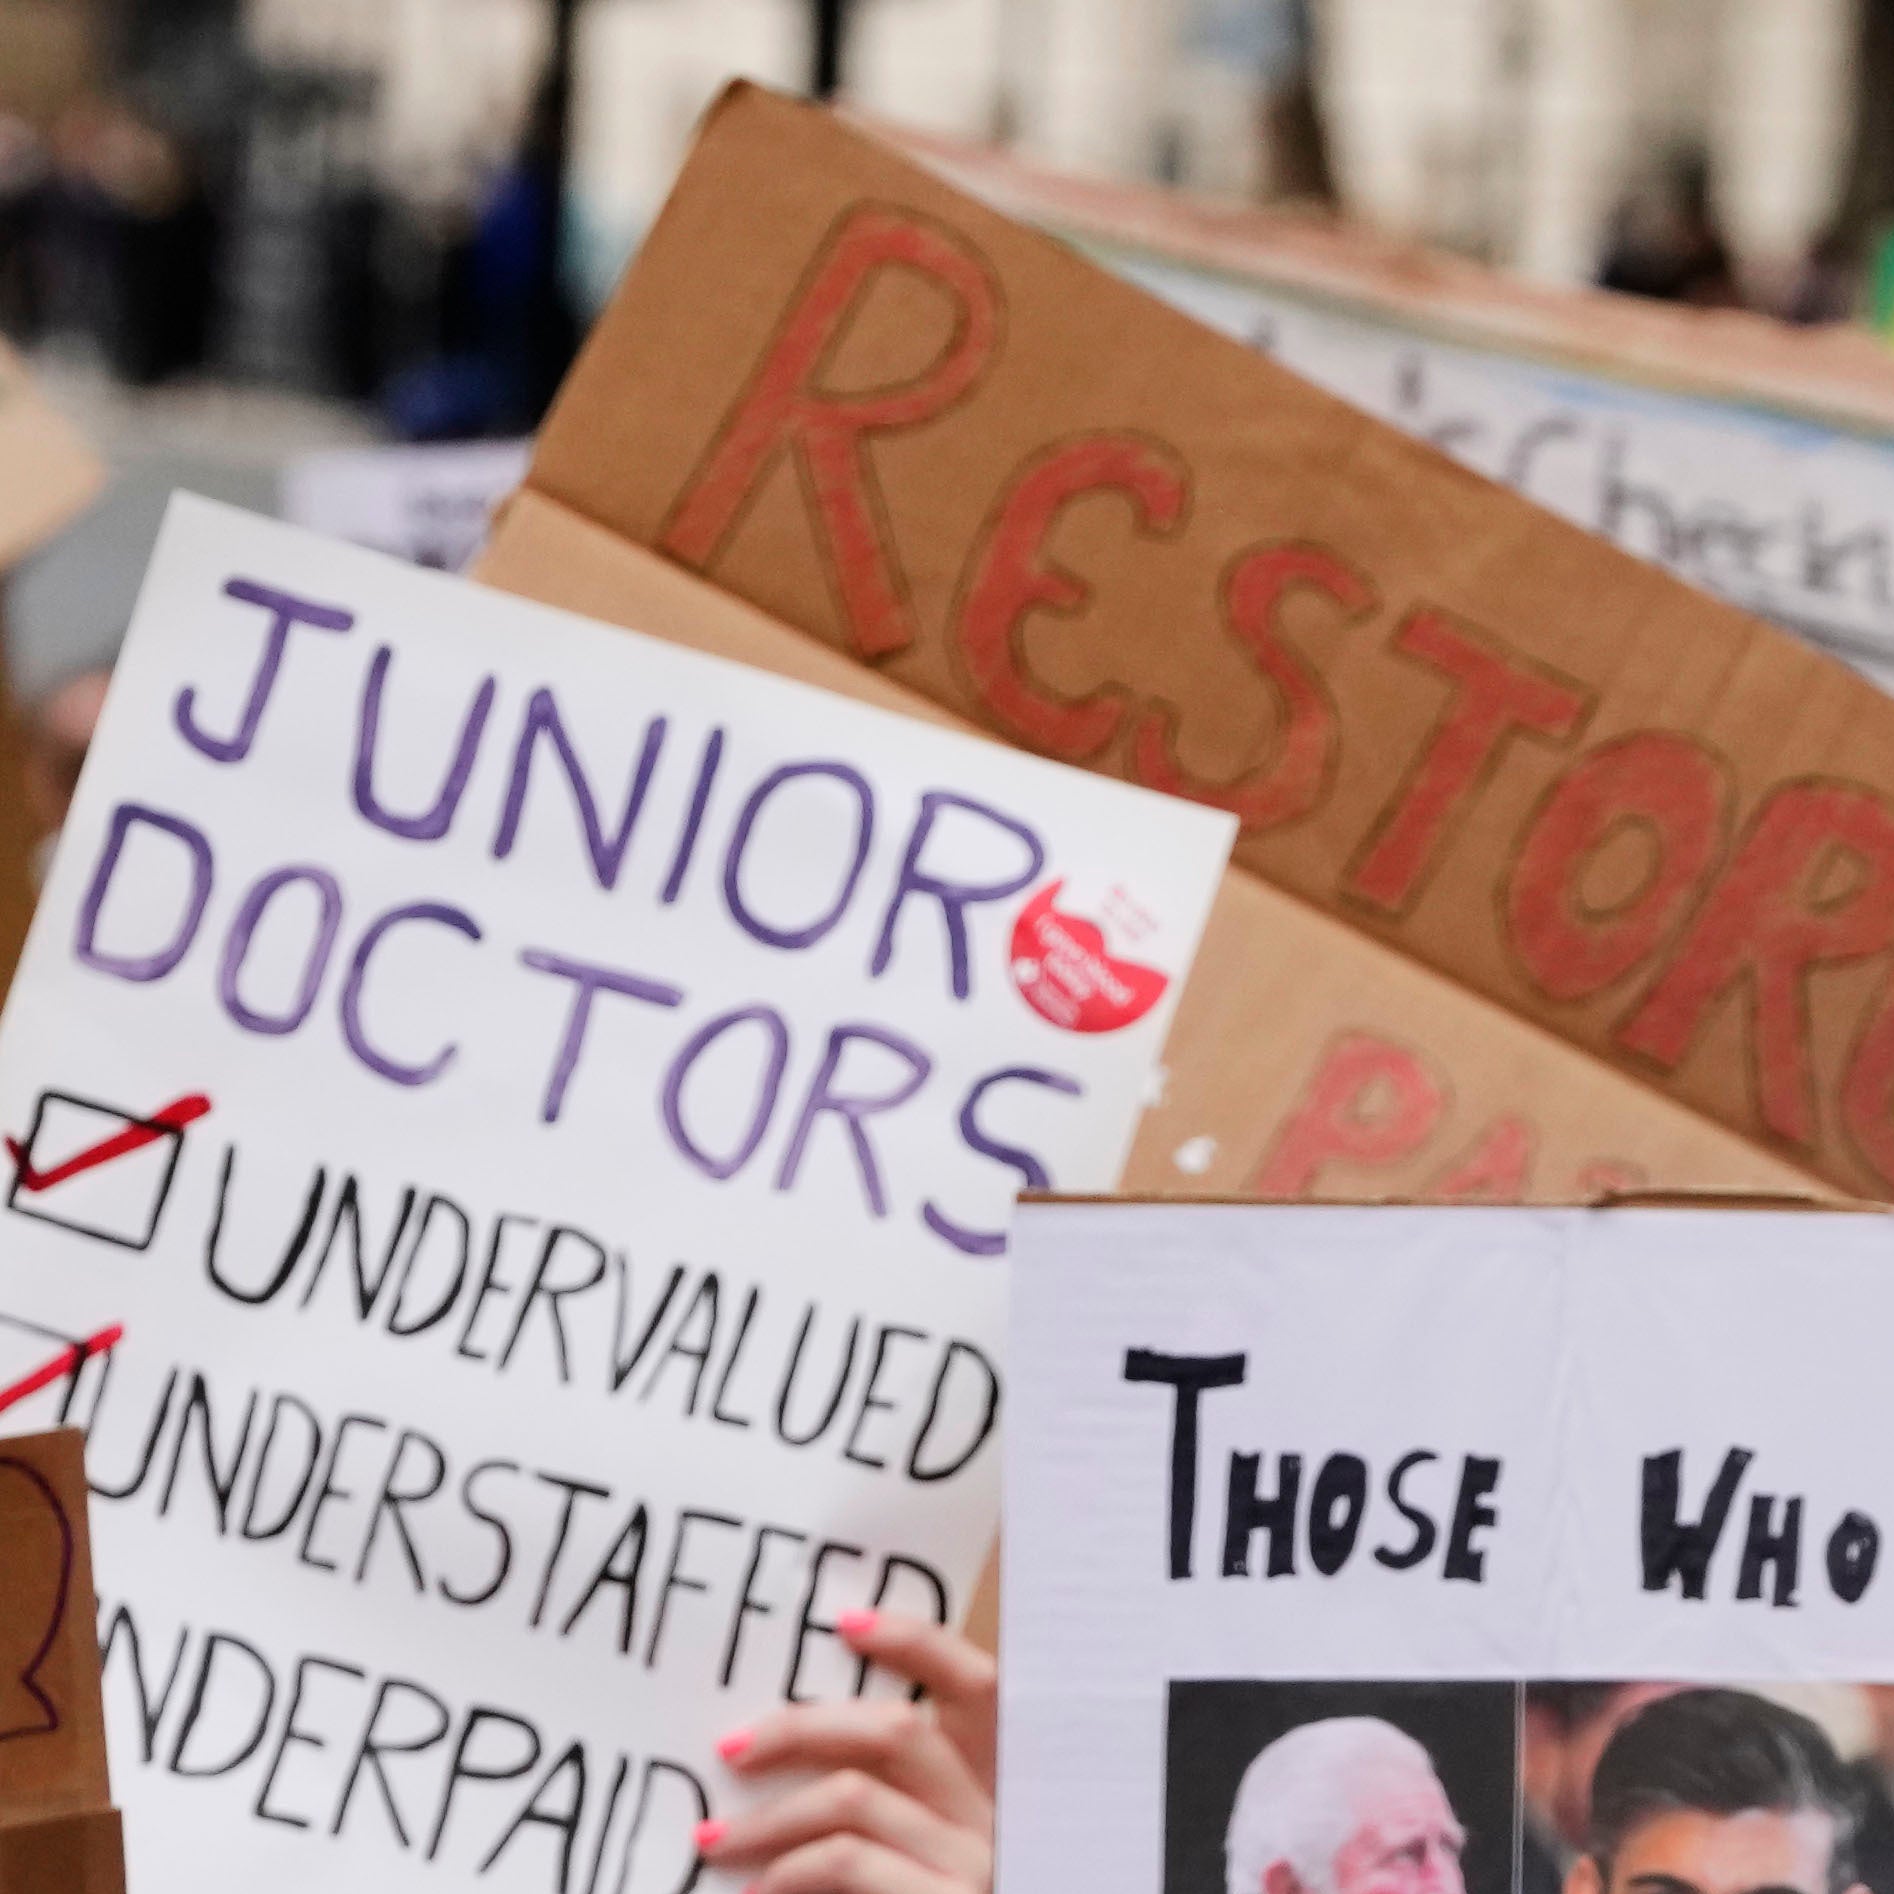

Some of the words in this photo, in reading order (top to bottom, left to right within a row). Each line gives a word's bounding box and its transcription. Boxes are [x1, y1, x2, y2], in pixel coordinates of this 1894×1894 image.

[173, 576, 1045, 1001] JUNIOR
[75, 802, 1085, 1257] DOCTORS
[205, 1143, 1001, 1484] UNDERVALUED
[1123, 1347, 1501, 1582] THOSE
[1640, 1446, 1882, 1607] WHO
